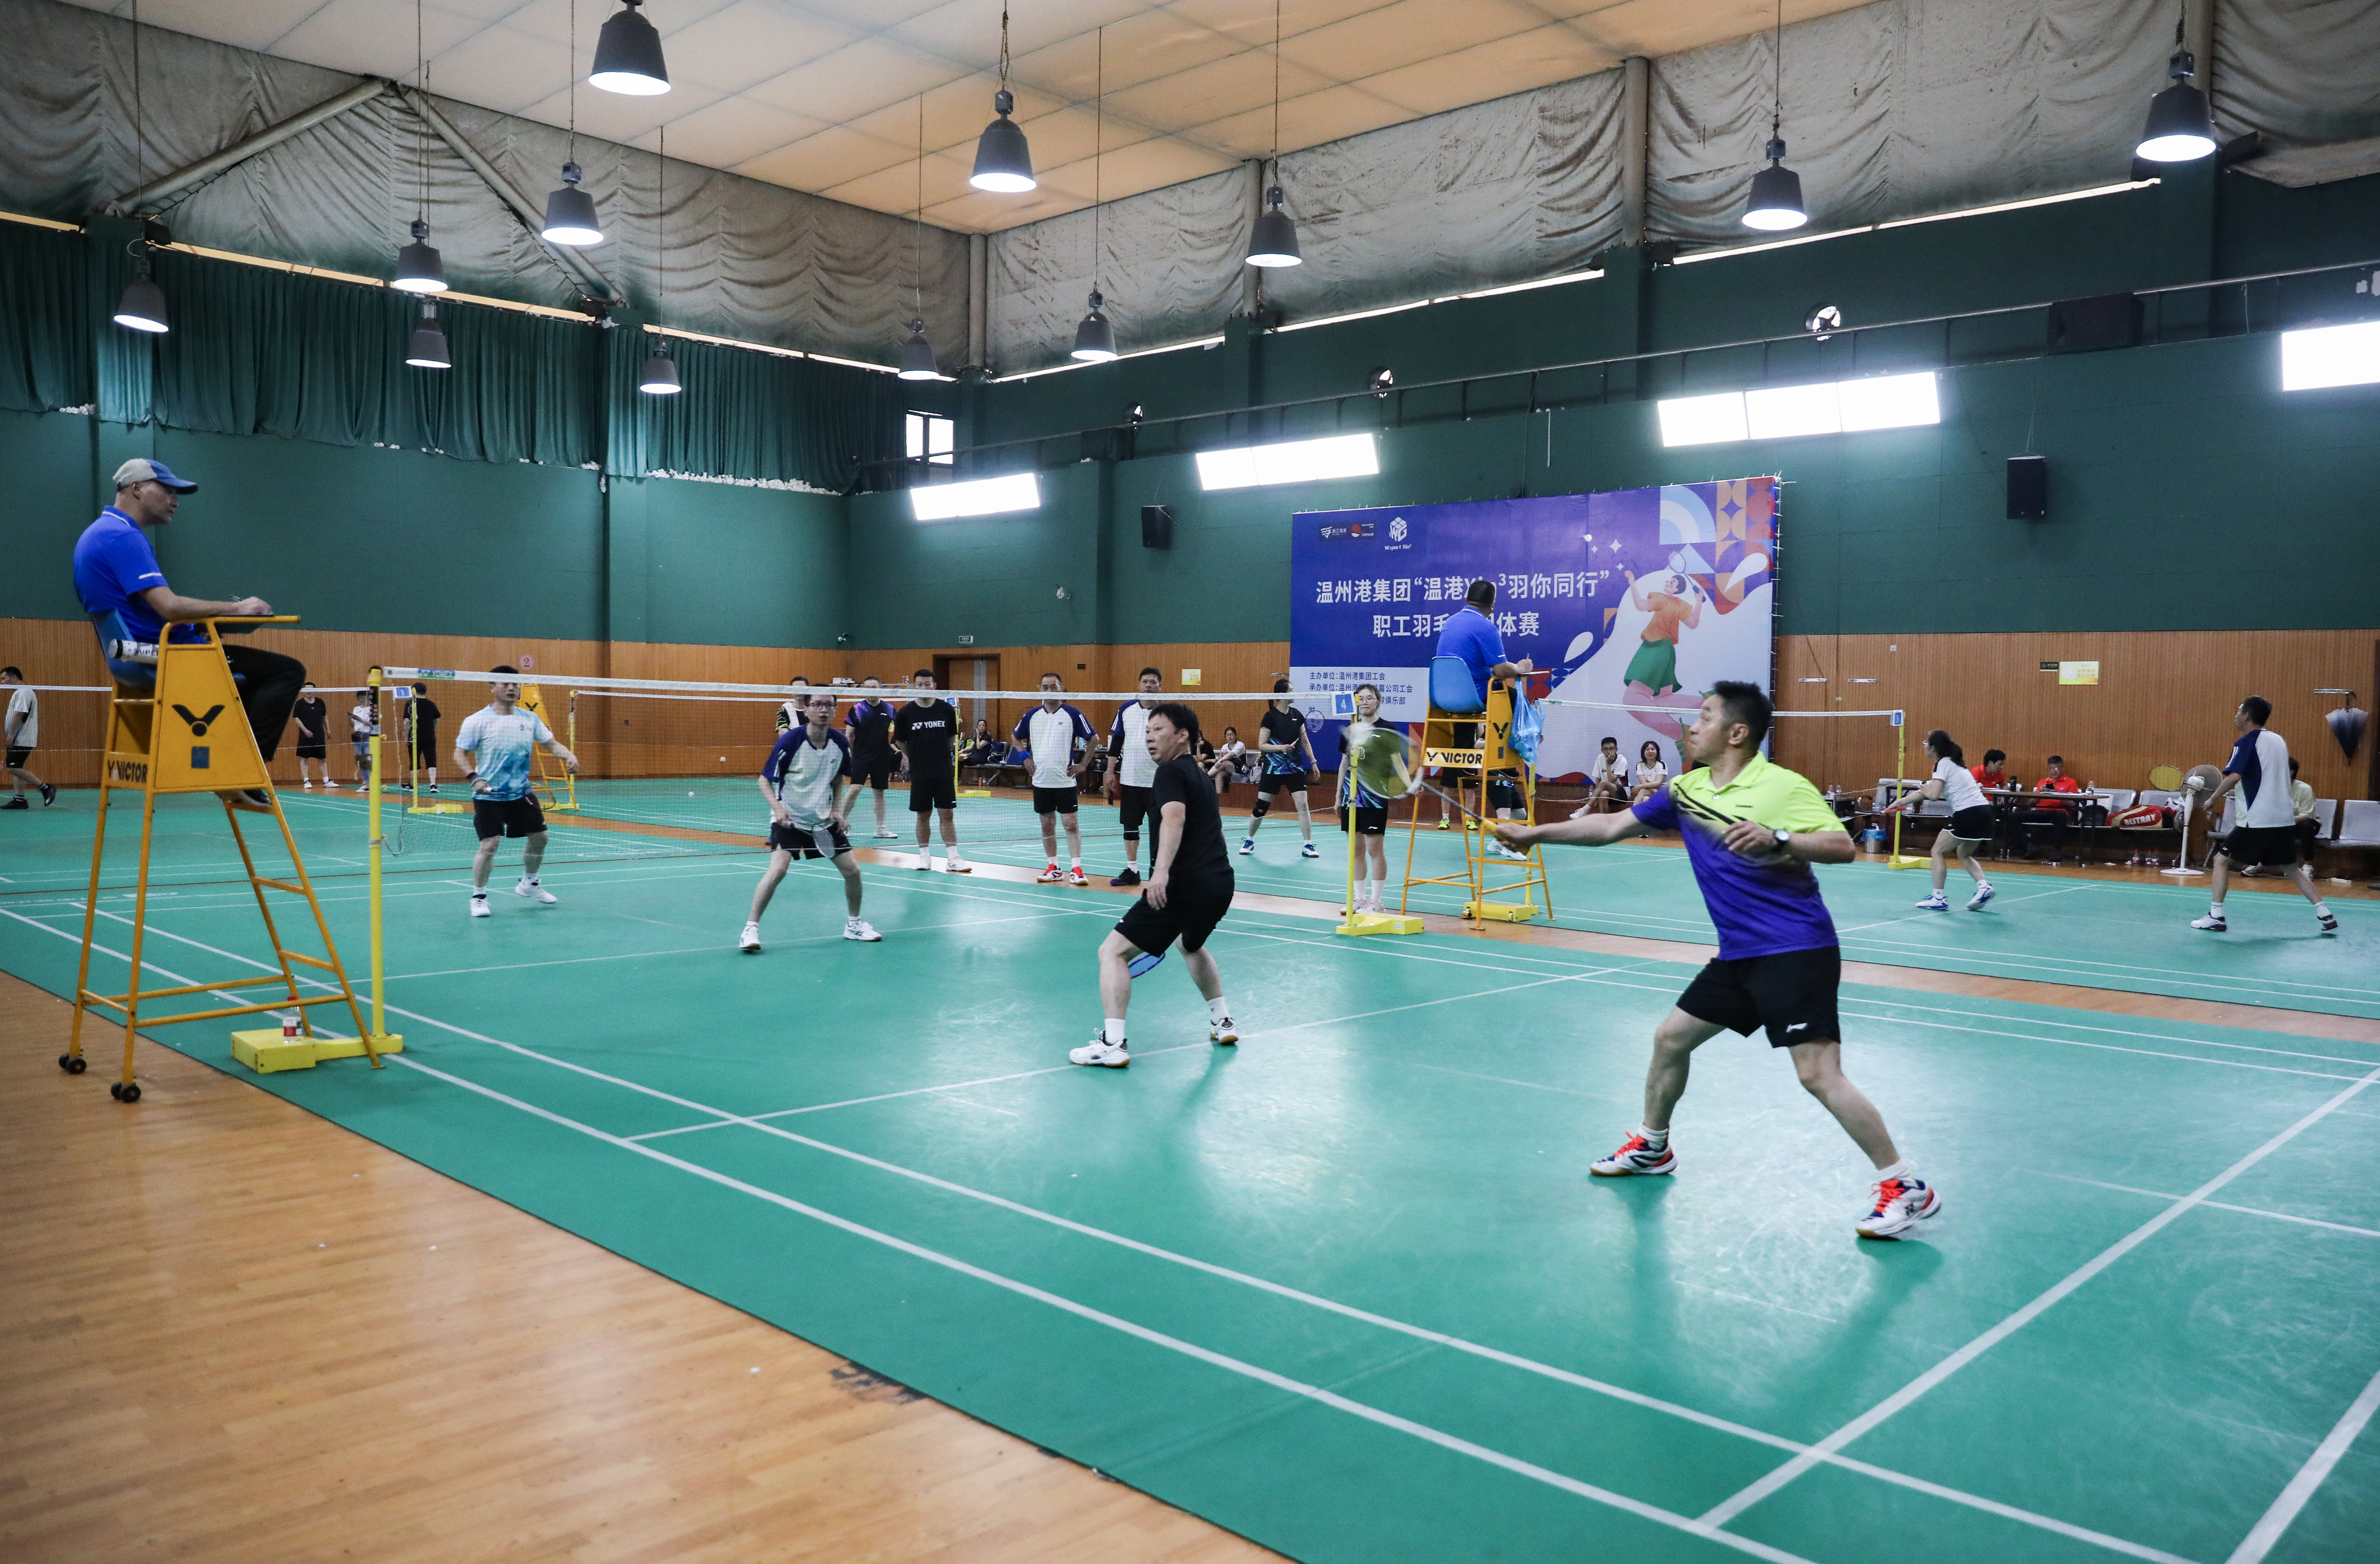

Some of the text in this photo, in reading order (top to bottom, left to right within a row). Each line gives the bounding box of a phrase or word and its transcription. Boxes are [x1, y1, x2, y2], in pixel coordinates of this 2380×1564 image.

[1373, 611, 1539, 638] 职工羽毛体赛
[1341, 699, 1347, 710] 4
[1895, 715, 1899, 723] 3
[1441, 752, 1482, 764] VICTOR
[117, 760, 148, 784] VICTOR
